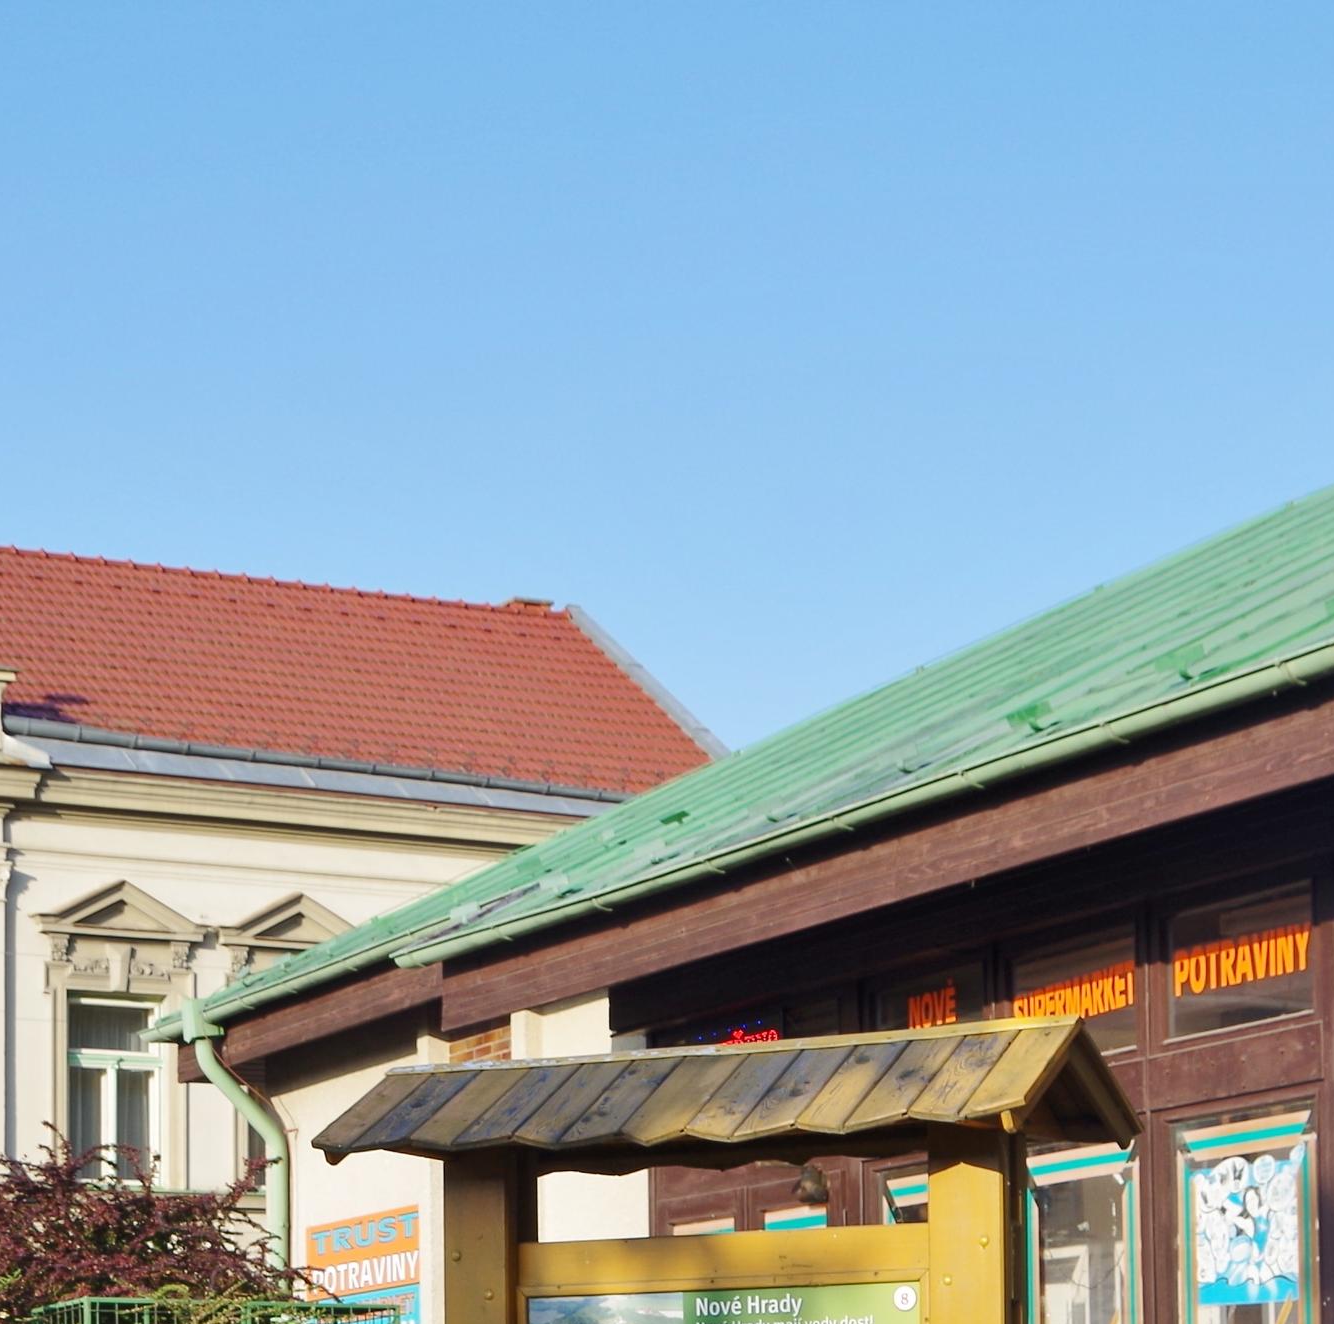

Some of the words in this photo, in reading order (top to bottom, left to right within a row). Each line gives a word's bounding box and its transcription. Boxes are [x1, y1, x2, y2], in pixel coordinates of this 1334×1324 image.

[907, 976, 957, 1029] NOVÉ
[1013, 960, 1135, 1018] SUPERMARKET
[1174, 922, 1311, 997] POTRAVINY
[310, 1210, 419, 1256] TRUST
[312, 1249, 419, 1294] POTRAVINY
[695, 1295, 742, 1317] Nové
[747, 1293, 803, 1318] Hrady
[900, 1292, 909, 1305] 8
